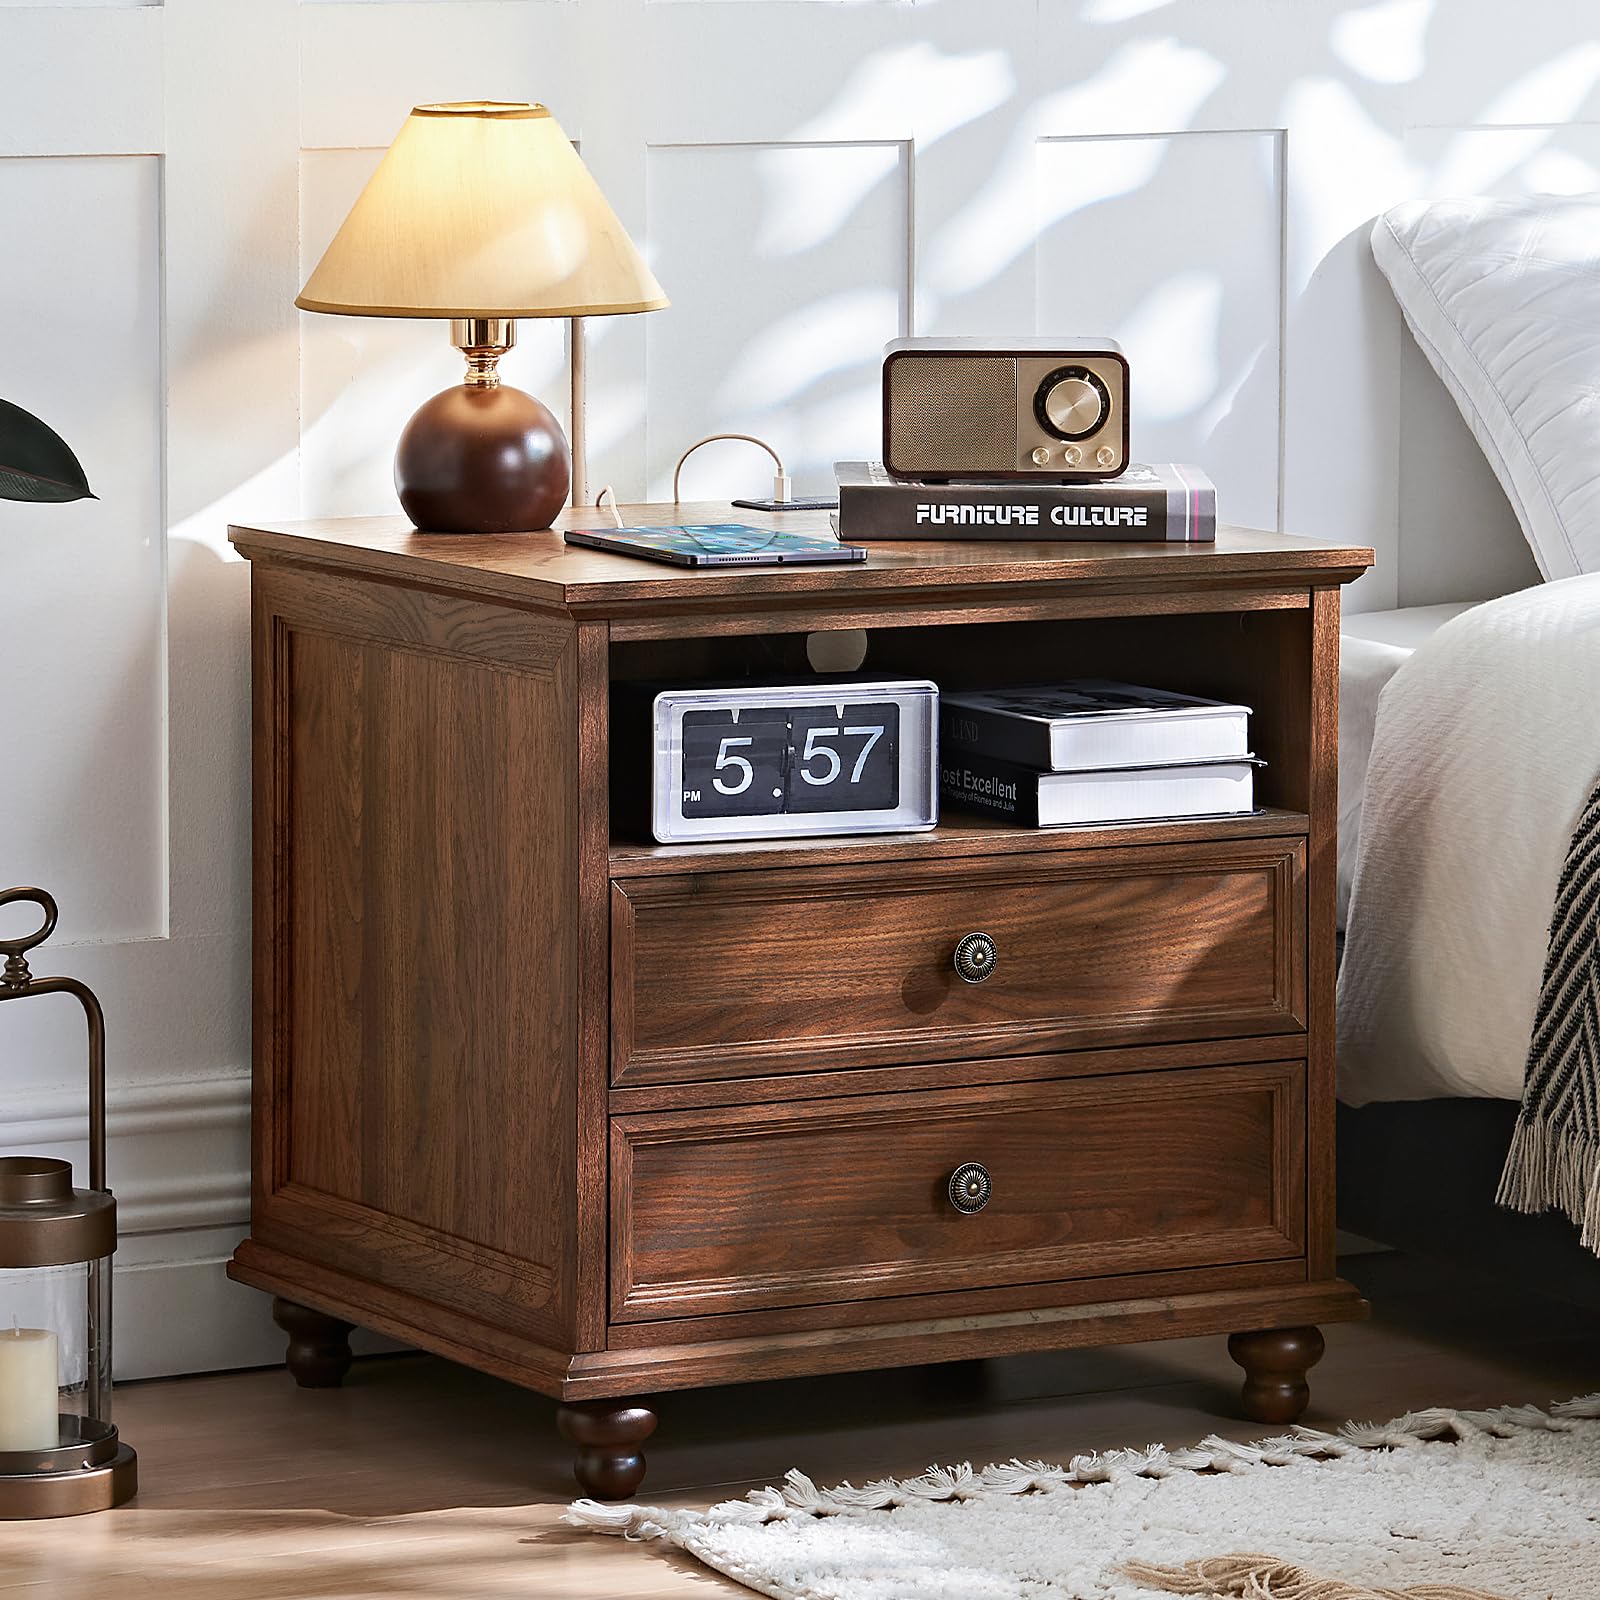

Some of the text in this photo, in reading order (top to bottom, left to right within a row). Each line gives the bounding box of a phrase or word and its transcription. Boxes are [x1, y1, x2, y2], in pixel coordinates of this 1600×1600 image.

[916, 504, 1148, 526] FURNITURE CULTURE
[712, 725, 885, 795] 5 57
[963, 769, 1017, 800] Excellent
[683, 790, 701, 802] PM
[992, 799, 1003, 809] and
